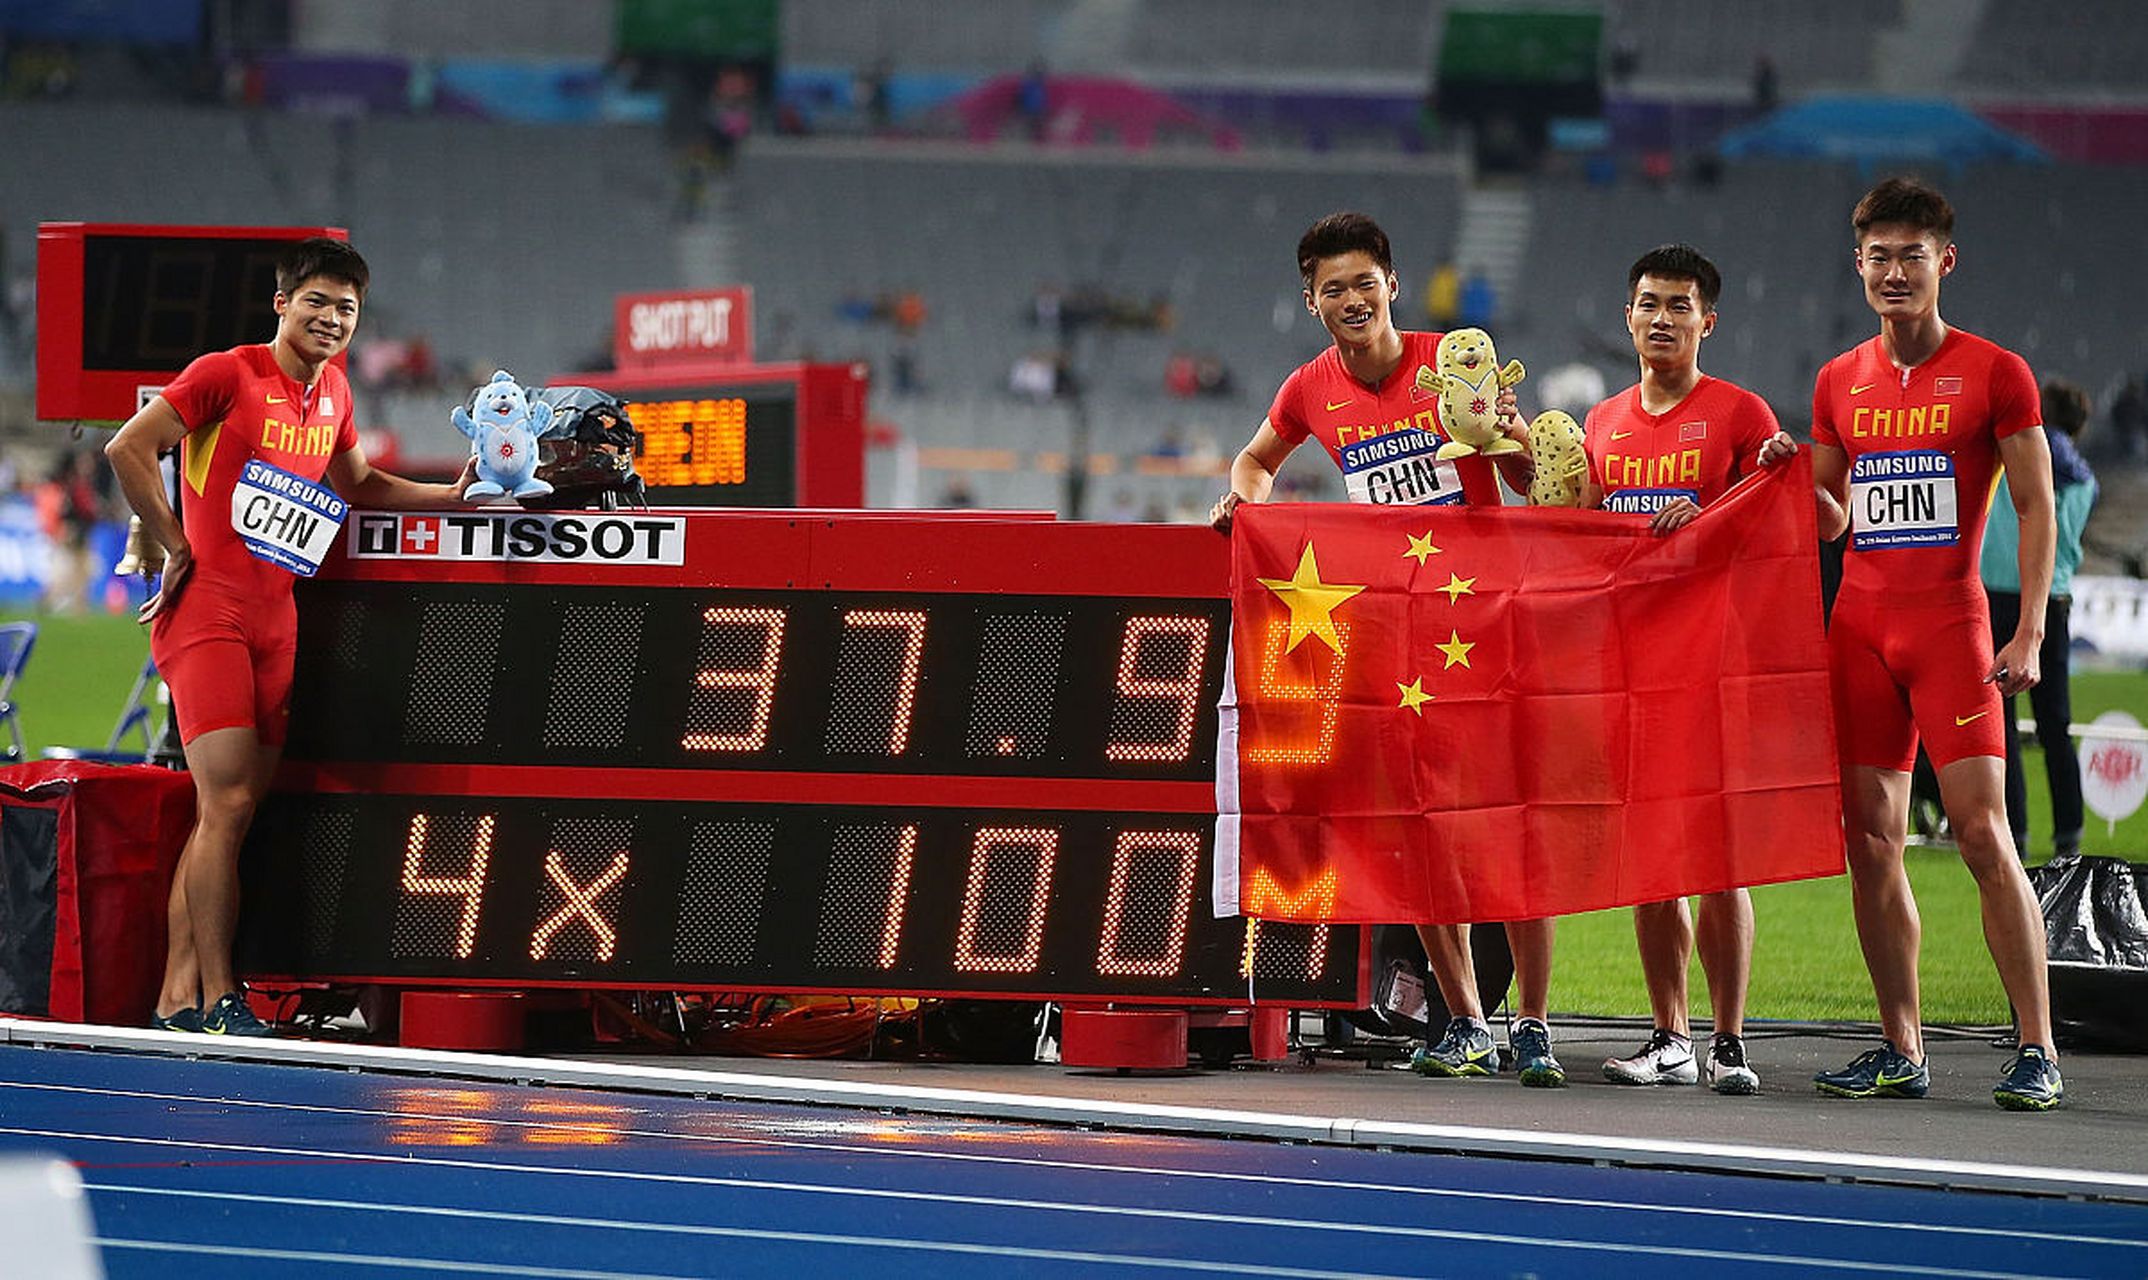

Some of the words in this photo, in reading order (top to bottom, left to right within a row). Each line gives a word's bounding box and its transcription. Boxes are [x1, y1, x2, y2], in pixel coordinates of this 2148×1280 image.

[629, 301, 687, 351] SHOT
[687, 298, 732, 348] PUT
[261, 419, 334, 456] CHINA
[1853, 404, 1950, 437] CHINA
[1346, 432, 1436, 468] SAMSUNG
[1606, 449, 1700, 487] CHINA
[1855, 456, 1947, 477] SAMSUNG
[247, 465, 343, 517] SAMSUNG
[1367, 457, 1441, 505] CHN
[243, 495, 320, 550] CHN
[1602, 495, 1691, 513] SAMSU
[1867, 483, 1936, 525] CHN
[447, 517, 675, 559] TISSOT
[682, 606, 1352, 764] 37.99
